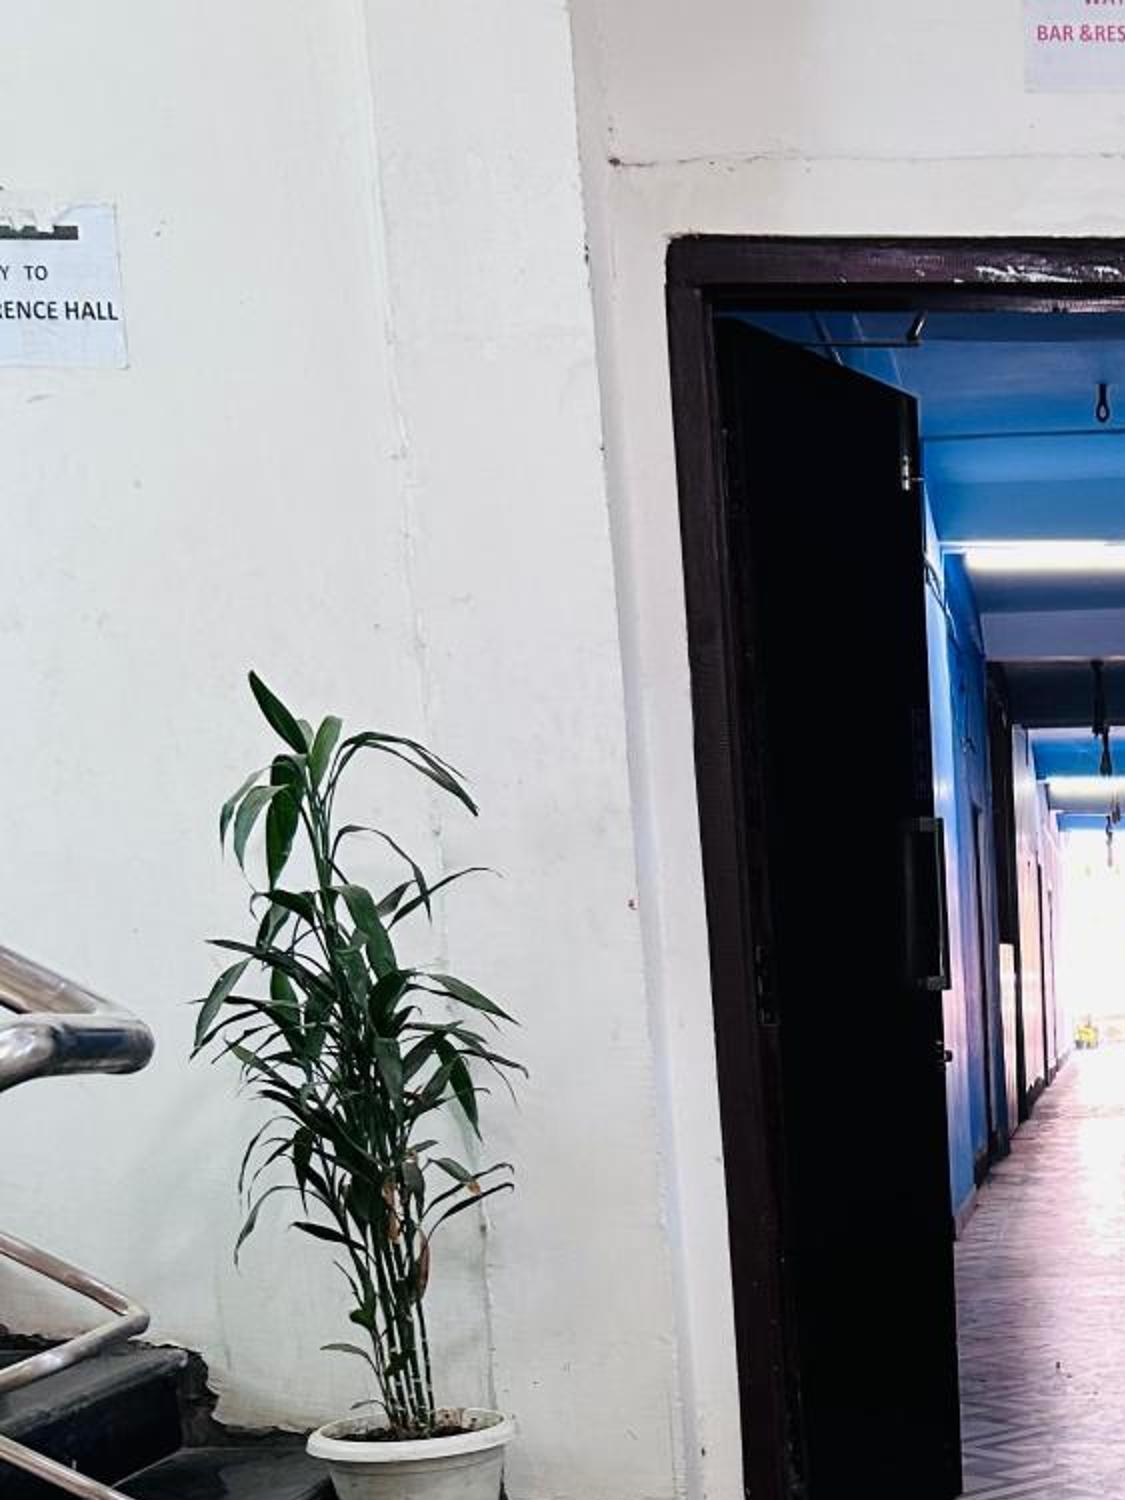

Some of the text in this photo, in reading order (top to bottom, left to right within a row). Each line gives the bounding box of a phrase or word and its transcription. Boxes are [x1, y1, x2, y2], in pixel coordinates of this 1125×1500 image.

[1037, 25, 1073, 42] BAR
[24, 265, 48, 281] TO
[0, 301, 118, 320] ENCE HALL
